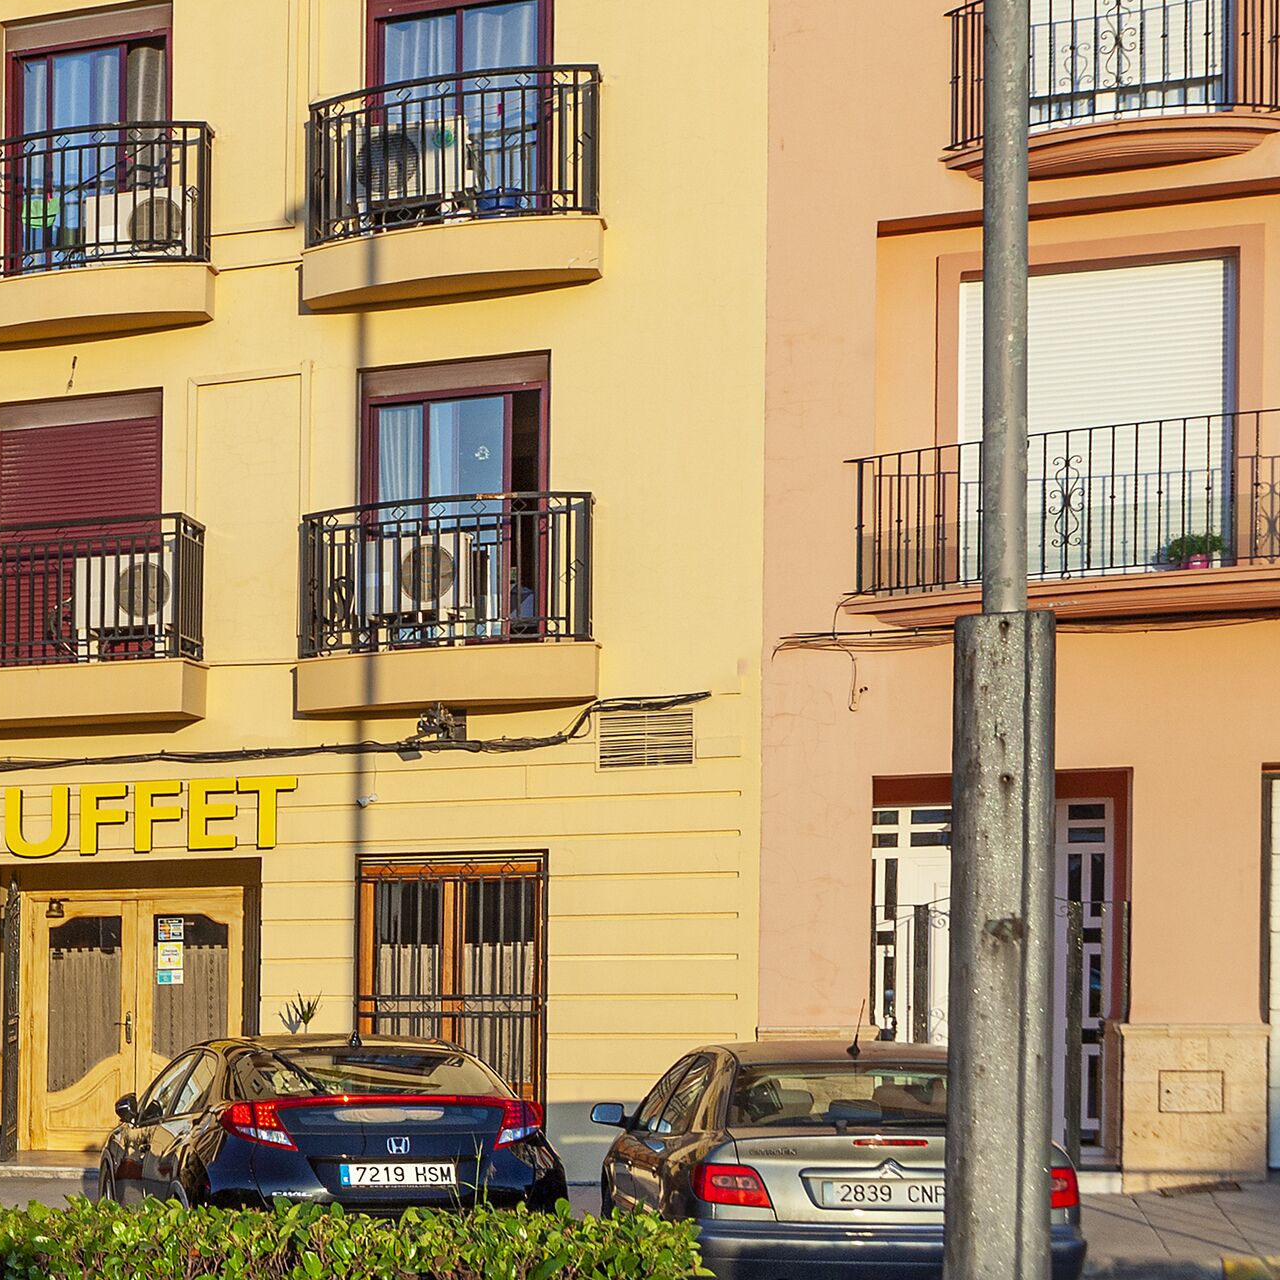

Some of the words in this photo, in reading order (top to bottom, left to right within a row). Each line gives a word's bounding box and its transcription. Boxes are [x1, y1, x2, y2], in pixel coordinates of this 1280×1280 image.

[355, 1167, 405, 1183] 7219
[415, 1166, 452, 1182] HSM
[840, 1185, 892, 1202] 2839
